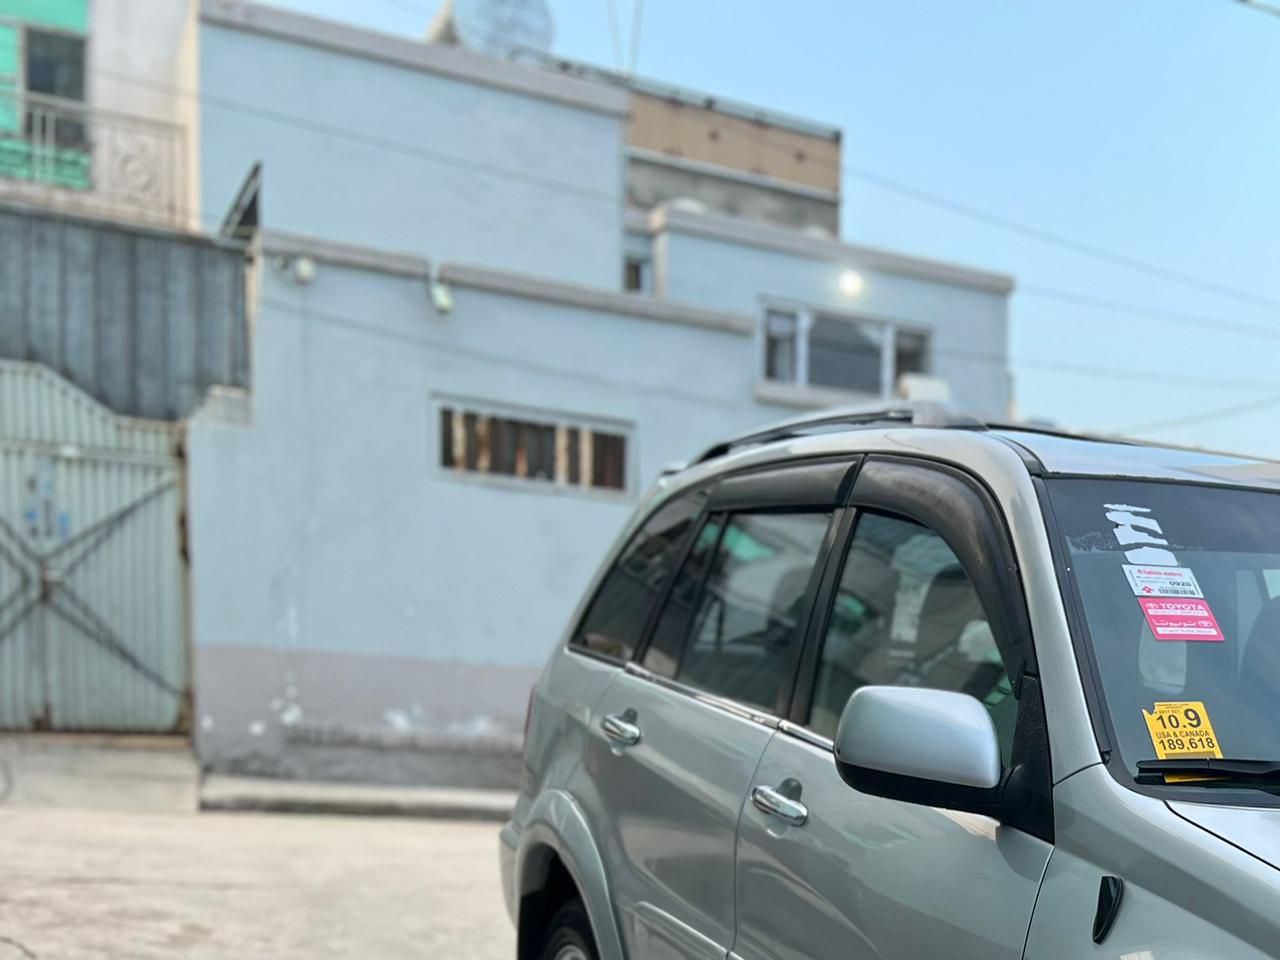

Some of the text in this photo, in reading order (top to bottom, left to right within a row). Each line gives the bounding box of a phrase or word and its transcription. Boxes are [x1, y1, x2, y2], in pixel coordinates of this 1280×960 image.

[1152, 618, 1196, 627] تويوتا
[1156, 708, 1201, 729] 10.9
[1156, 731, 1173, 739] USA
[1180, 730, 1210, 738] CANADA
[1159, 737, 1215, 751] 189,618
